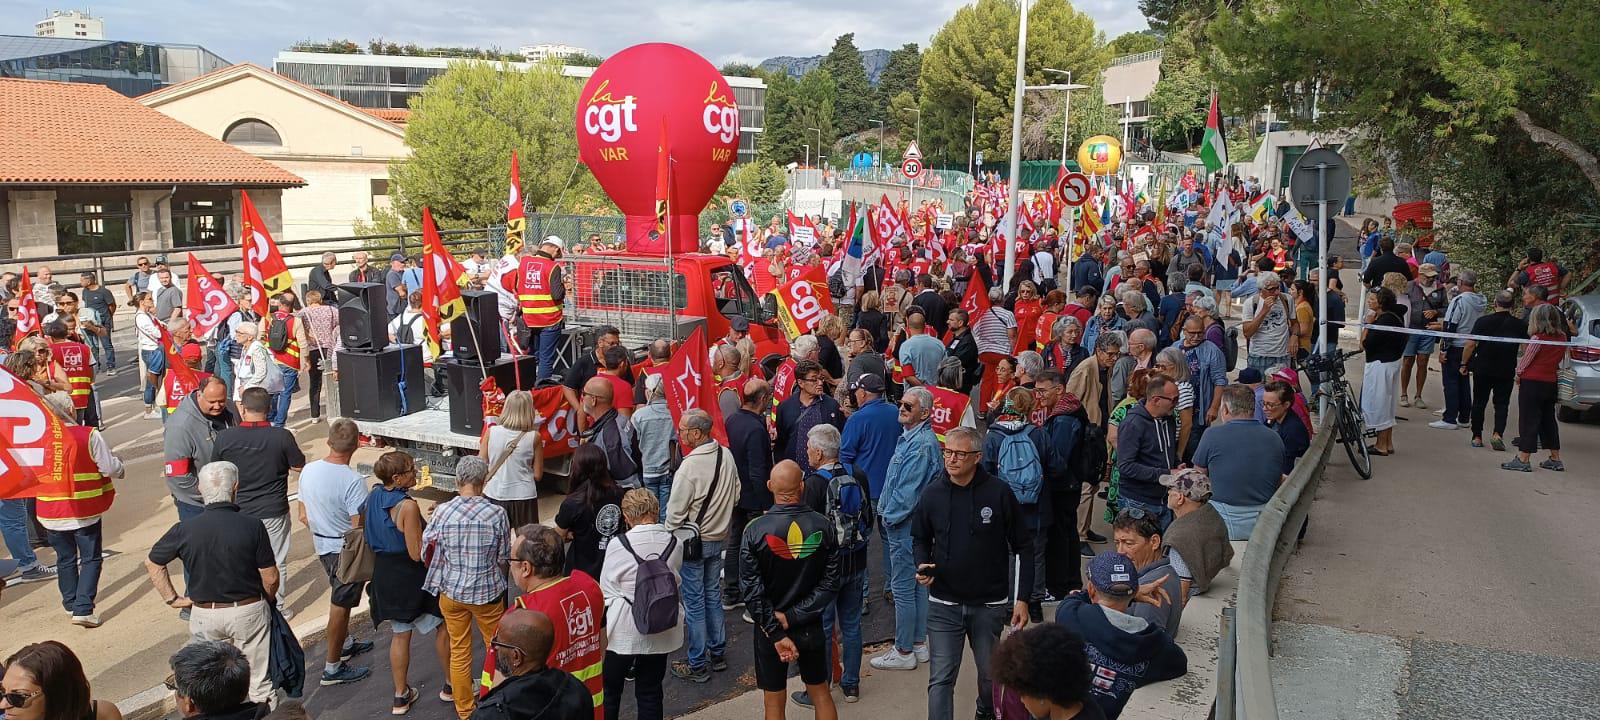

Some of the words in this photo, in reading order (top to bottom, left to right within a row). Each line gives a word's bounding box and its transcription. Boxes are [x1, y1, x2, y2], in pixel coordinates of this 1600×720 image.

[587, 80, 637, 105] la
[585, 95, 638, 143] cgt
[703, 101, 740, 144] cgt
[599, 147, 630, 162] VAR
[712, 148, 732, 162] VAR
[906, 164, 918, 173] 30
[526, 271, 541, 283] cgt
[790, 280, 830, 331] cgt
[63, 355, 83, 366] cgt
[567, 607, 593, 635] cgt
